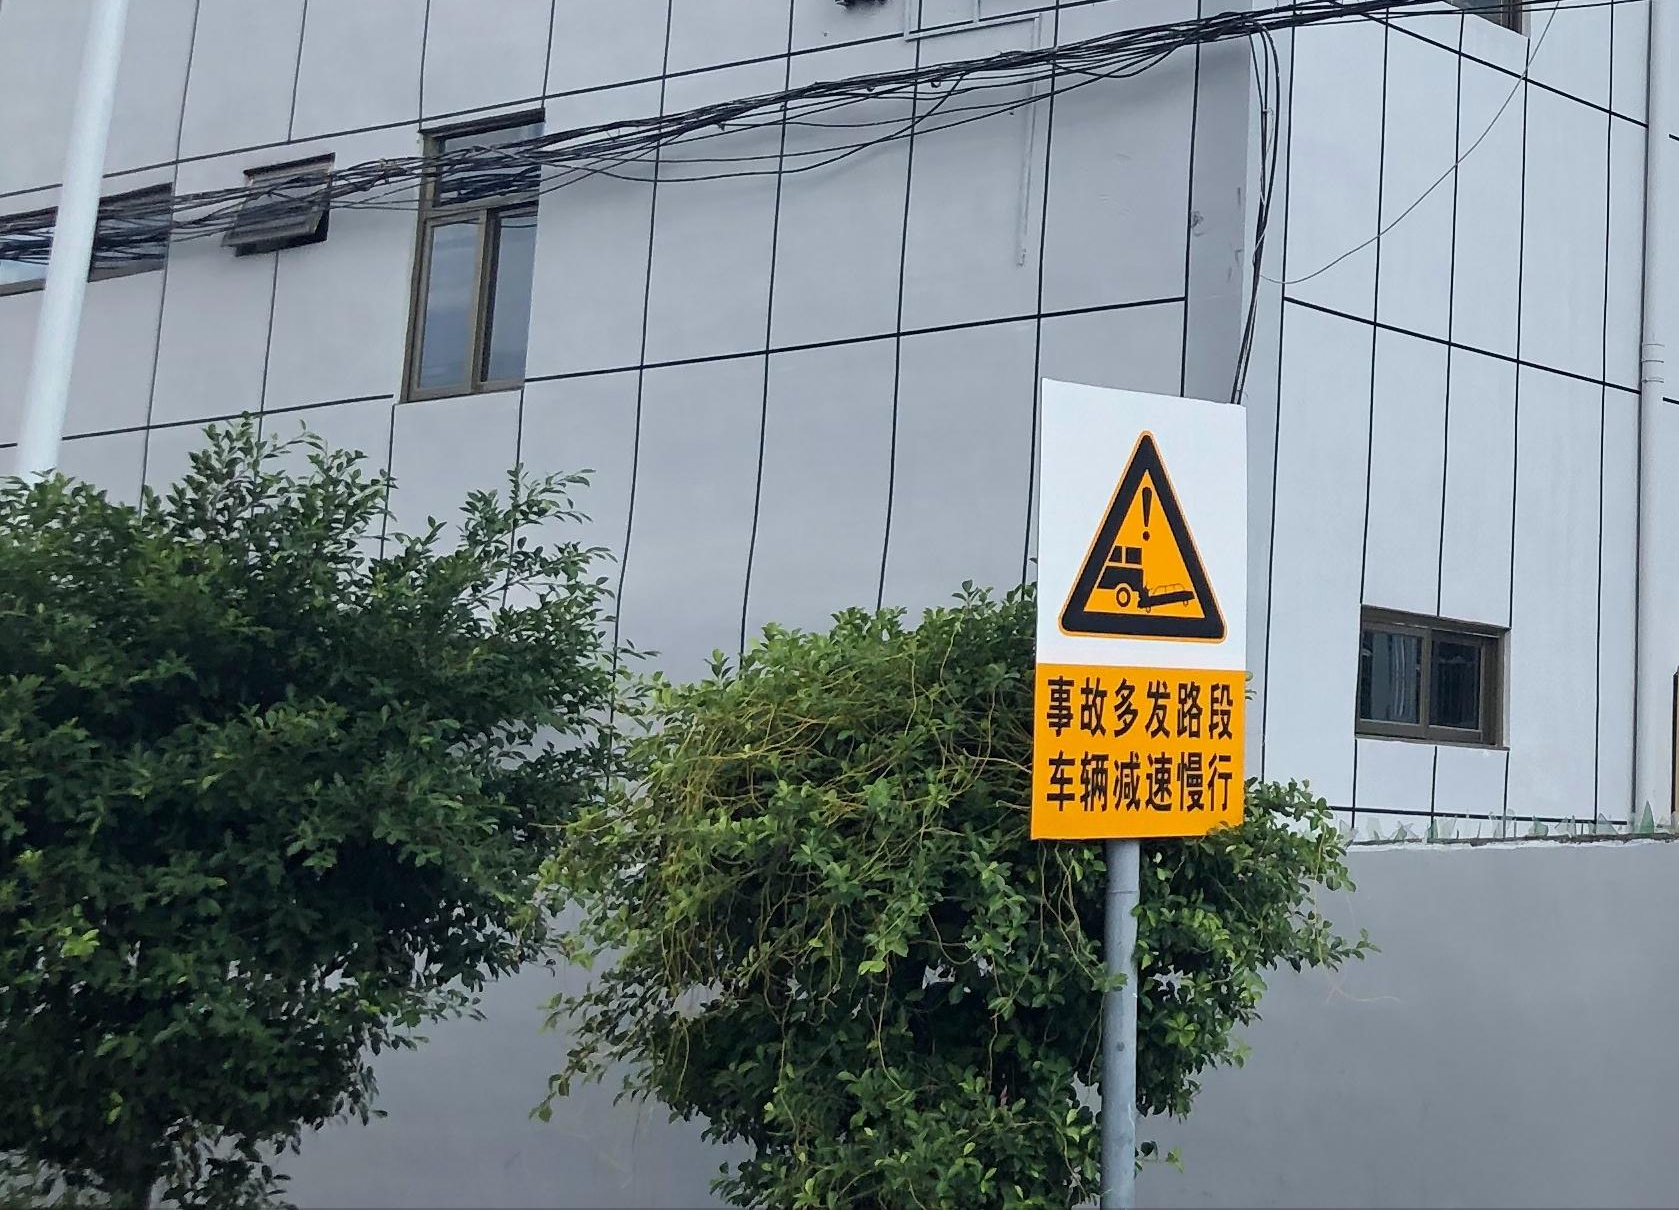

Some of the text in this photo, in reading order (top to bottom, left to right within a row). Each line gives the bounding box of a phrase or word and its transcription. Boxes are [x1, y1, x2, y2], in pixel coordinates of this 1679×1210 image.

[1046, 676, 1234, 740] 事故多发路段
[1046, 750, 1234, 813] 车辆减速慢行
